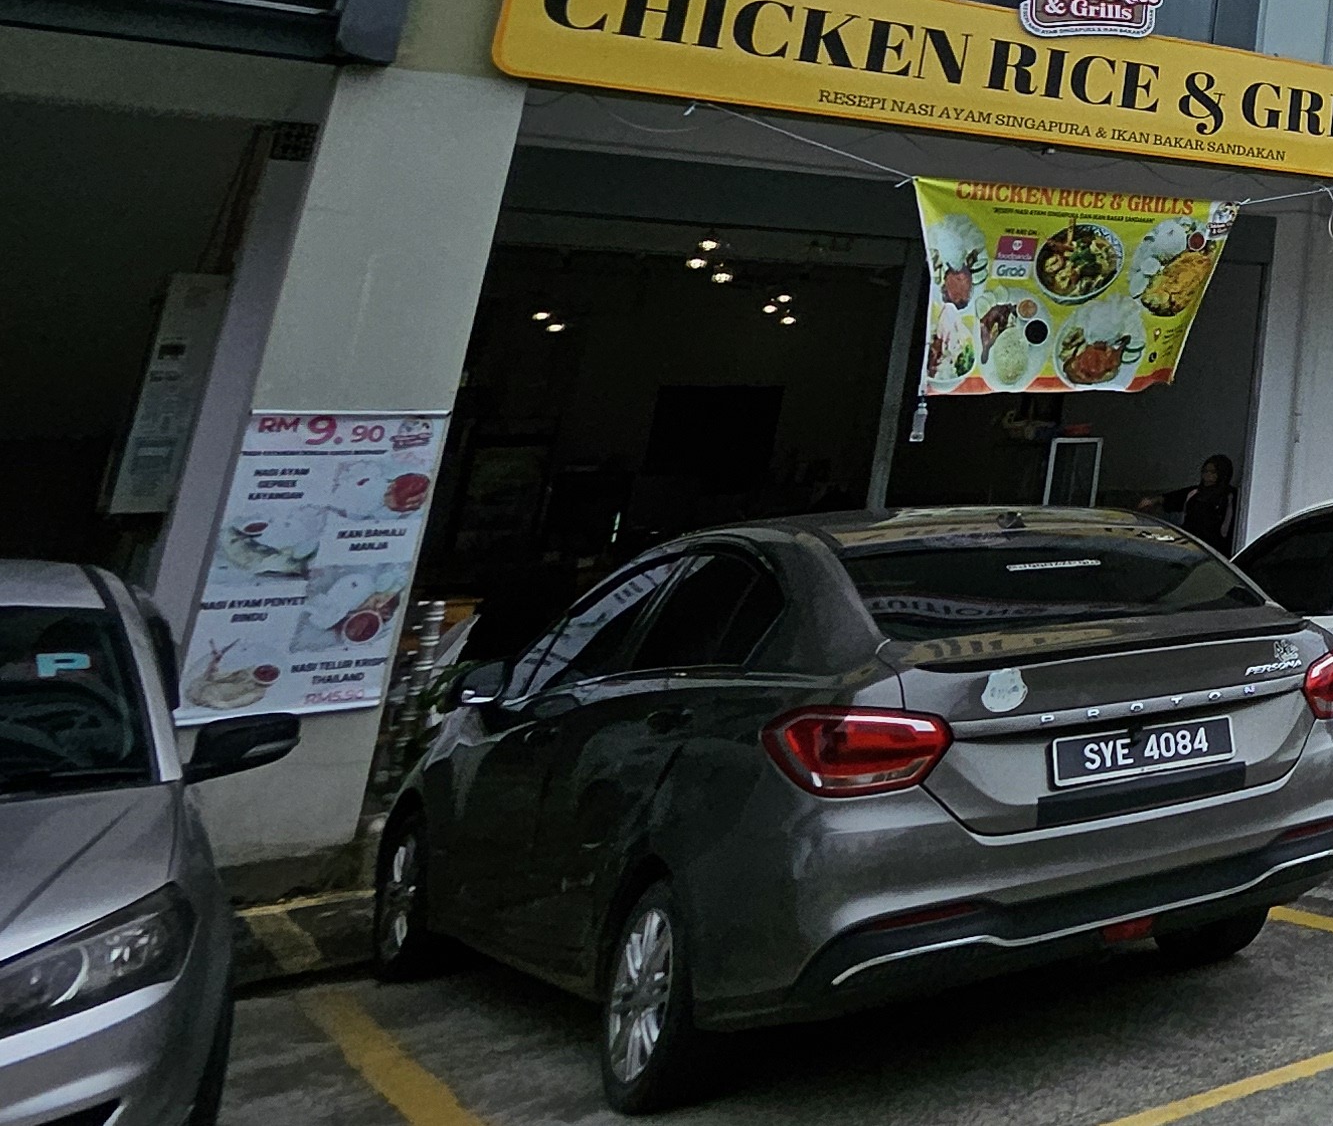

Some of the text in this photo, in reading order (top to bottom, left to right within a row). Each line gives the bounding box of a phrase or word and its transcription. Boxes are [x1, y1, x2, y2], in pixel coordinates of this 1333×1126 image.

[982, 38, 1161, 114] RICE
[1178, 71, 1226, 136] &
[818, 88, 1286, 162] RESEPI NASI AYAM SINGAPURA & IKAN BAKAR SANDAKAN
[956, 181, 1194, 215] CHICKEN RICE & GRILLS
[996, 264, 1026, 277] Grab
[257, 417, 300, 433] RM
[336, 529, 364, 539] IKAN
[200, 596, 306, 611] NASI AYAM PENYET
[290, 662, 319, 673] NASI
[319, 659, 355, 671] TELUR
[1245, 659, 1303, 676] PERSONA
[311, 673, 365, 685] THAILAND
[1040, 684, 1257, 724] PROTON
[1083, 726, 1209, 772] SYE 4084
